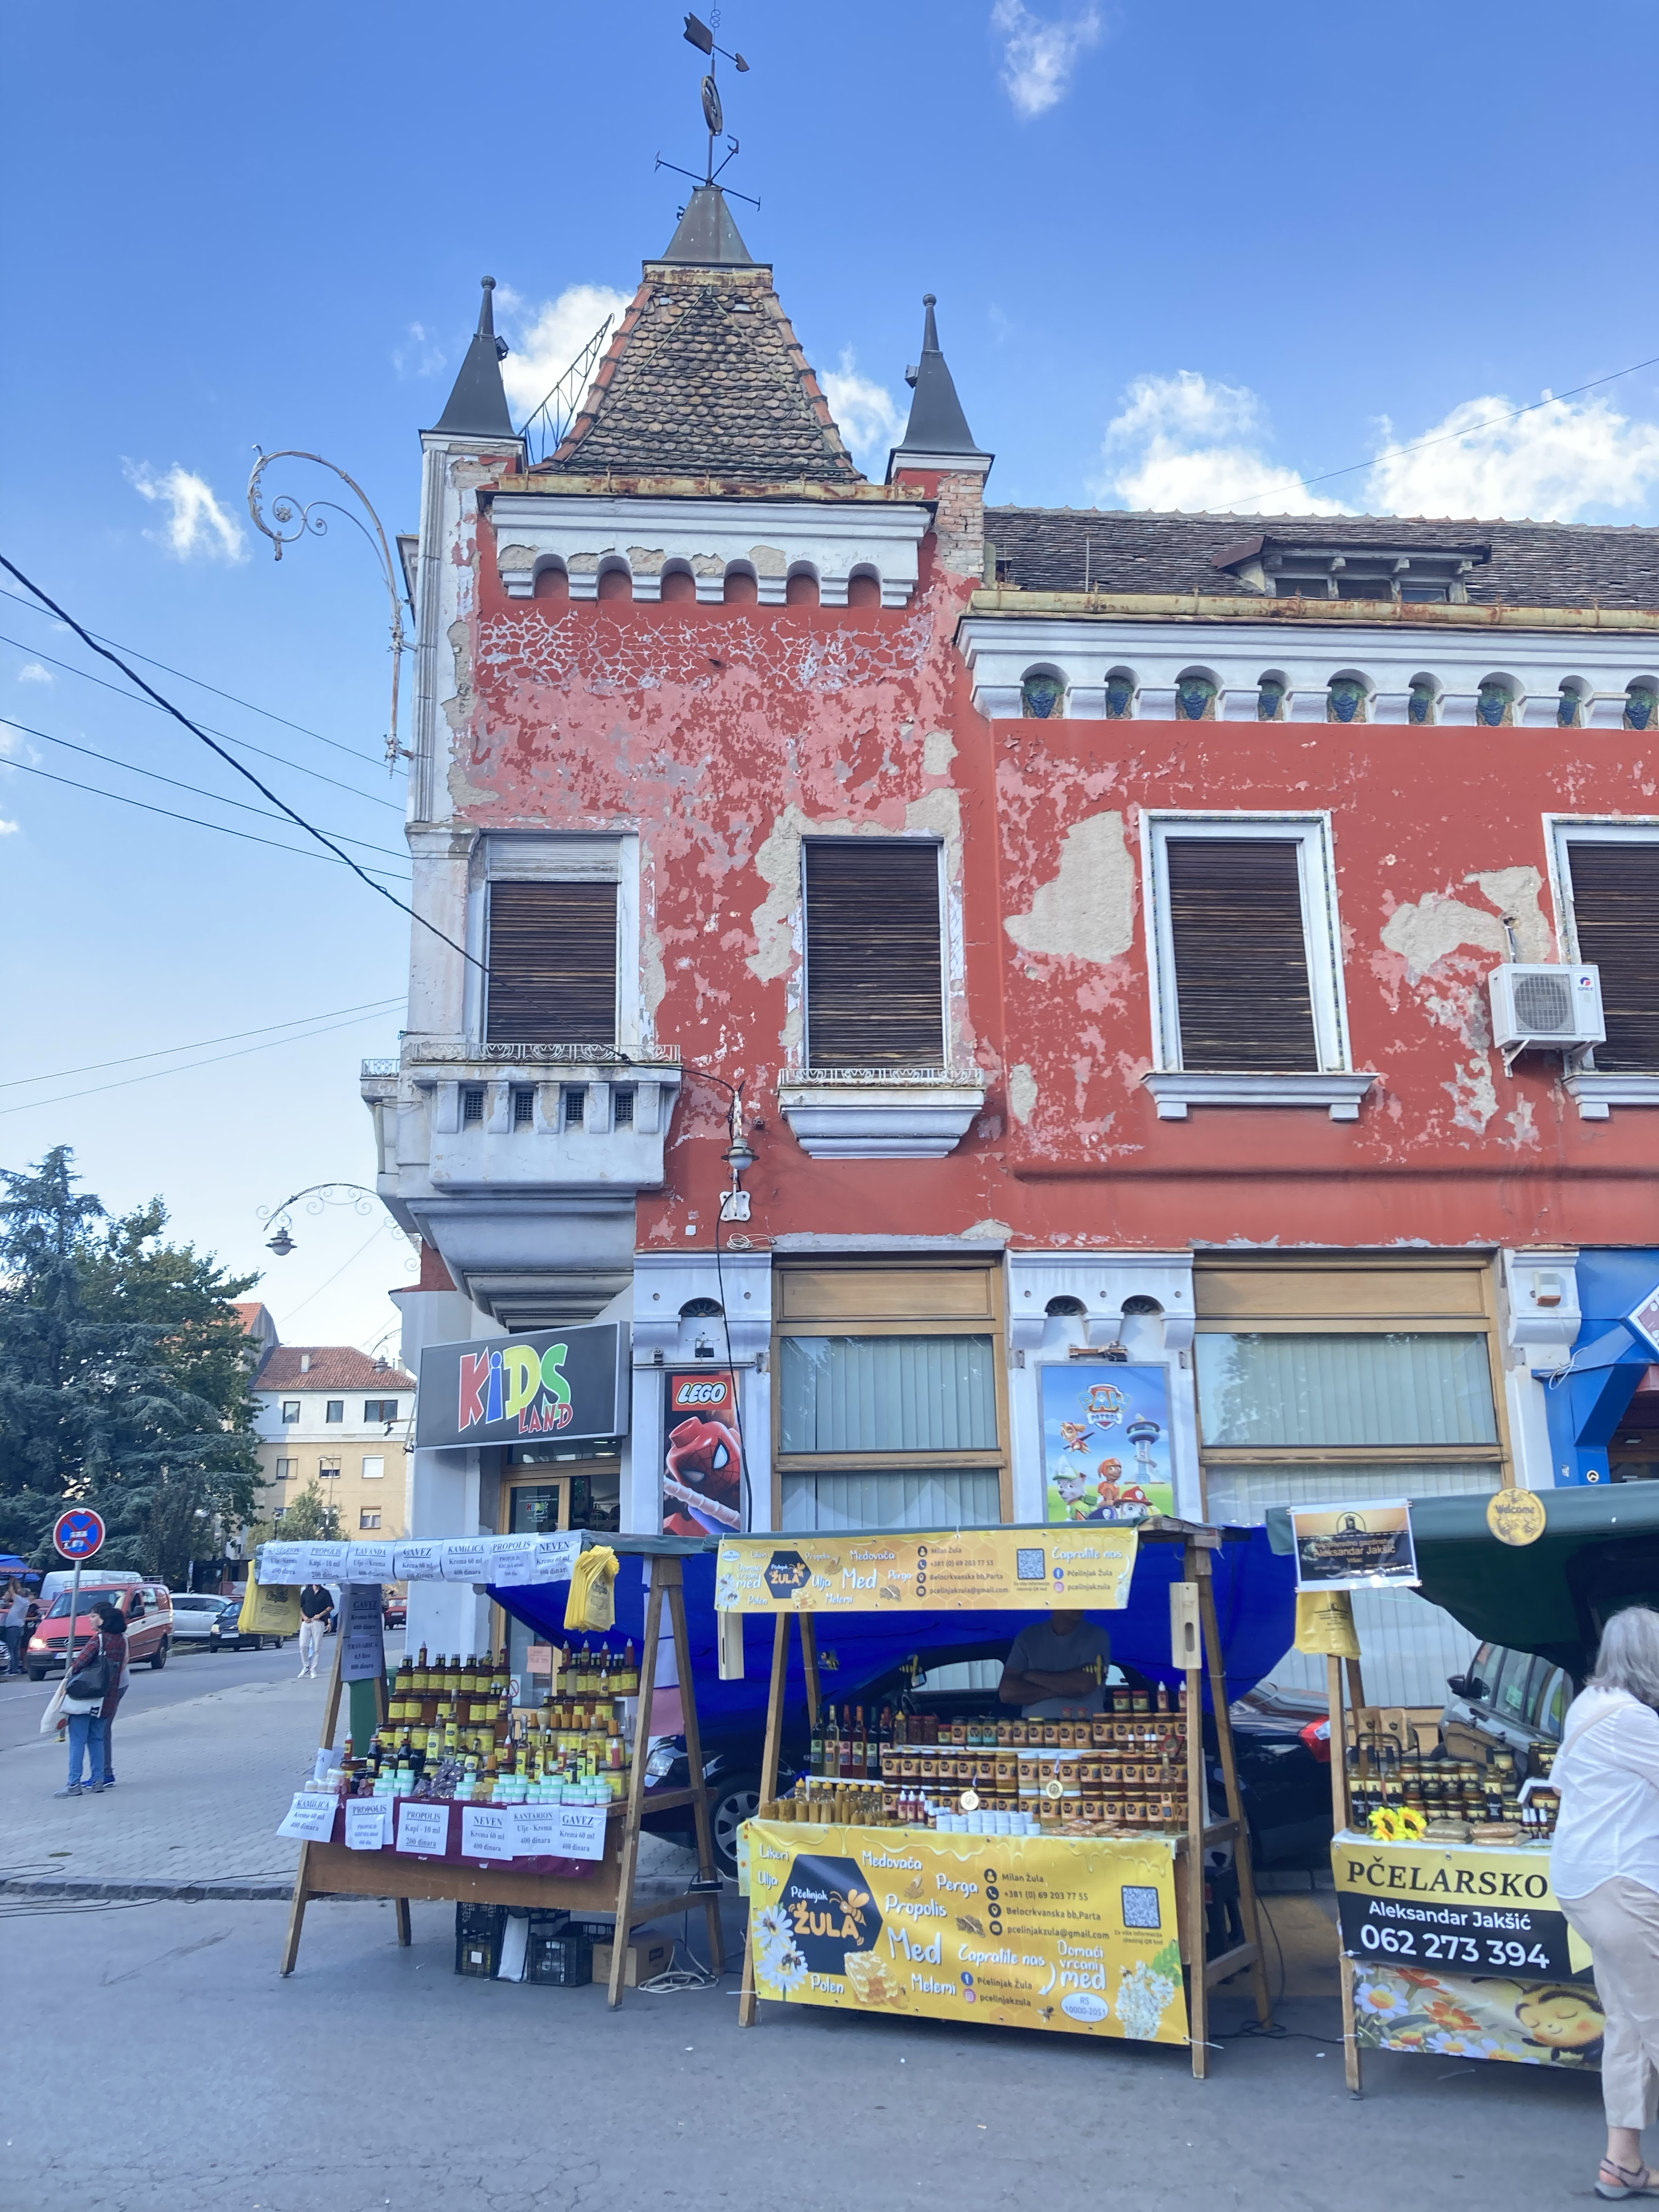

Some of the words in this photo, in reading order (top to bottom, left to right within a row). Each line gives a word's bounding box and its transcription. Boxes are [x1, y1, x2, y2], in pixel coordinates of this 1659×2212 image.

[676, 1382, 726, 1405] LEGO
[1078, 1391, 1132, 1413] PAW
[518, 1402, 573, 1434] LAND
[1091, 1413, 1119, 1421] PATROL
[1496, 1504, 1535, 1514] Welcome
[403, 1548, 432, 1556] GAVEZ
[448, 1544, 484, 1553] KAMILICA
[493, 1541, 531, 1551] PROPOLIS
[539, 1541, 570, 1552] NEVEN
[751, 1550, 768, 1559] Likeri
[805, 1552, 831, 1561] Propolis
[850, 1550, 895, 1561] Medovača
[1052, 1547, 1100, 1563] Zapratite
[1103, 1550, 1122, 1559] nas
[309, 1559, 321, 1567] Kapi
[771, 1571, 800, 1584] ŽULA
[843, 1567, 877, 1590] Med
[888, 1570, 912, 1581] Perga
[1098, 1568, 1113, 1577] Žula
[736, 1575, 761, 1589] med
[812, 1575, 832, 1591] Ulja
[1068, 1583, 1110, 1592] pcelinjakzula
[929, 1586, 1009, 1594] pcelinjakzula@gmail.com
[353, 1600, 377, 1609] GAVEZ
[748, 1595, 767, 1605] Polen
[826, 1593, 853, 1605] Melemi
[348, 1642, 378, 1650] TRAVARICA
[297, 1799, 329, 1809] KAMILICA
[353, 1804, 386, 1814] PROPOLIS
[407, 1810, 441, 1820] PROPOLIS
[474, 1815, 503, 1827] NEVEN
[514, 1812, 552, 1820] KANTARION
[562, 1814, 594, 1826] GAVEZ
[300, 1822, 319, 1831] dinara
[405, 1824, 419, 1834] Kapi
[470, 1830, 489, 1838] Krema
[417, 1838, 436, 1847] dinara
[483, 1843, 501, 1852] dinara
[572, 1844, 590, 1852] dinara
[759, 1844, 789, 1861] Likeri
[862, 1850, 923, 1871] Medovača
[758, 1871, 779, 1889] Ulja
[1002, 1873, 1025, 1882] Milan
[1026, 1872, 1045, 1883] Žula
[1347, 1855, 1549, 1899] PČELARSKO
[935, 1873, 979, 1898] Perga
[791, 1885, 828, 1904] Pčelinjak
[1004, 1891, 1023, 1899] +381
[1025, 1891, 1036, 1900] (0)
[1038, 1892, 1048, 1900] 69
[1050, 1892, 1065, 1900] 203
[1066, 1892, 1077, 1900] 77
[1079, 1893, 1088, 1901] 55
[885, 1893, 947, 1922] Propolis
[1006, 1907, 1065, 1919] Belocrkvanska
[793, 1900, 859, 1939] ŽULA
[1369, 1900, 1469, 1926] Aleksandar
[1472, 1910, 1532, 1931] Jakšić
[1007, 1925, 1110, 1940] pcelinjakzula@gmail.com
[887, 1926, 942, 1966] Med
[1057, 1940, 1104, 1960] Domaći
[1361, 1924, 1417, 1956] 062
[1423, 1933, 1480, 1962] 273
[1486, 1940, 1550, 1970] 394
[958, 1944, 1018, 1967] Zapratite
[1023, 1954, 1046, 1967] nas
[1060, 1959, 1100, 1971] vrcani
[1060, 1962, 1106, 1990] med
[810, 1975, 845, 1995] Polen
[911, 1973, 957, 1996] Melemi
[977, 1976, 1013, 1989] Pčelinjak
[1014, 1976, 1032, 1990] Žula
[980, 1993, 1031, 2007] pcelinjakzula
[1080, 1997, 1090, 2005] RS
[1065, 2005, 1106, 2017] 10000-2051
